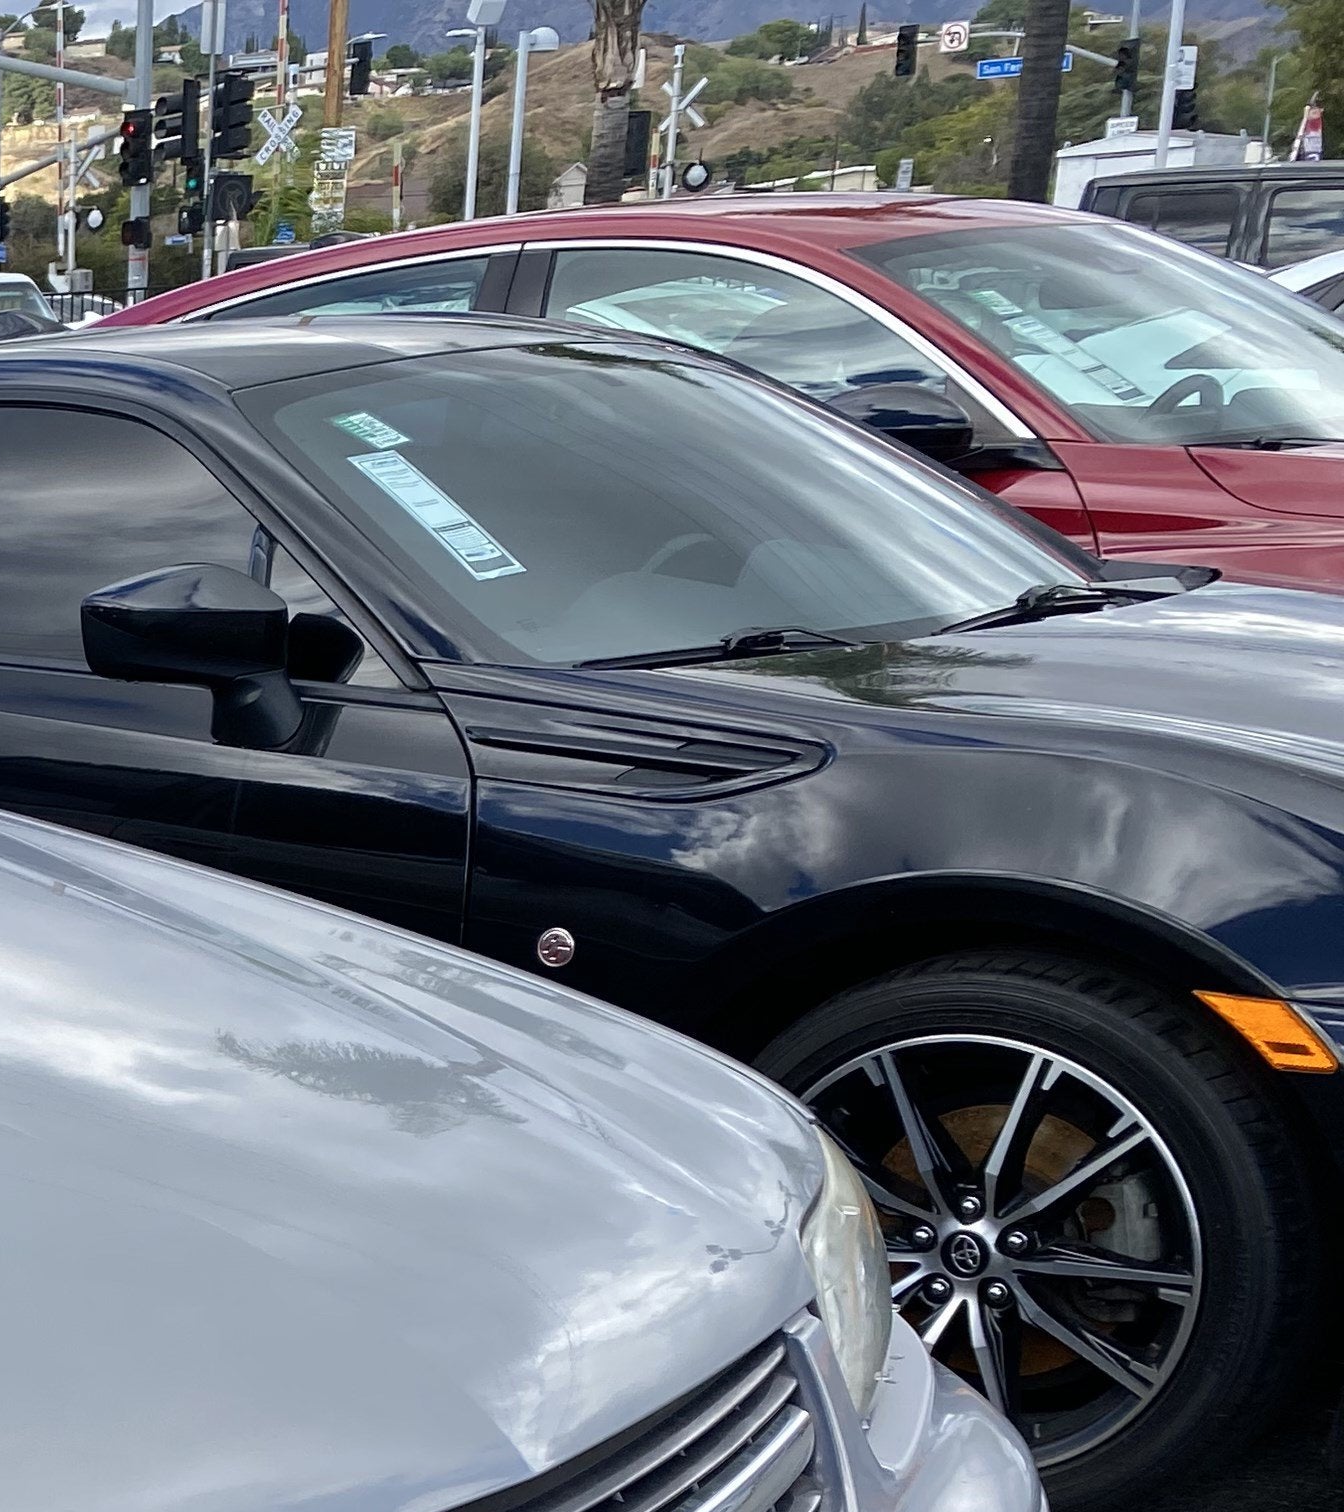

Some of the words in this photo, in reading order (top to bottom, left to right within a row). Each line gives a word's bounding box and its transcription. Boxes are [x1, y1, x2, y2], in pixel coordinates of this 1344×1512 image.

[981, 64, 1002, 75] San
[260, 111, 277, 132] RAIL
[258, 109, 300, 161] CROSSING
